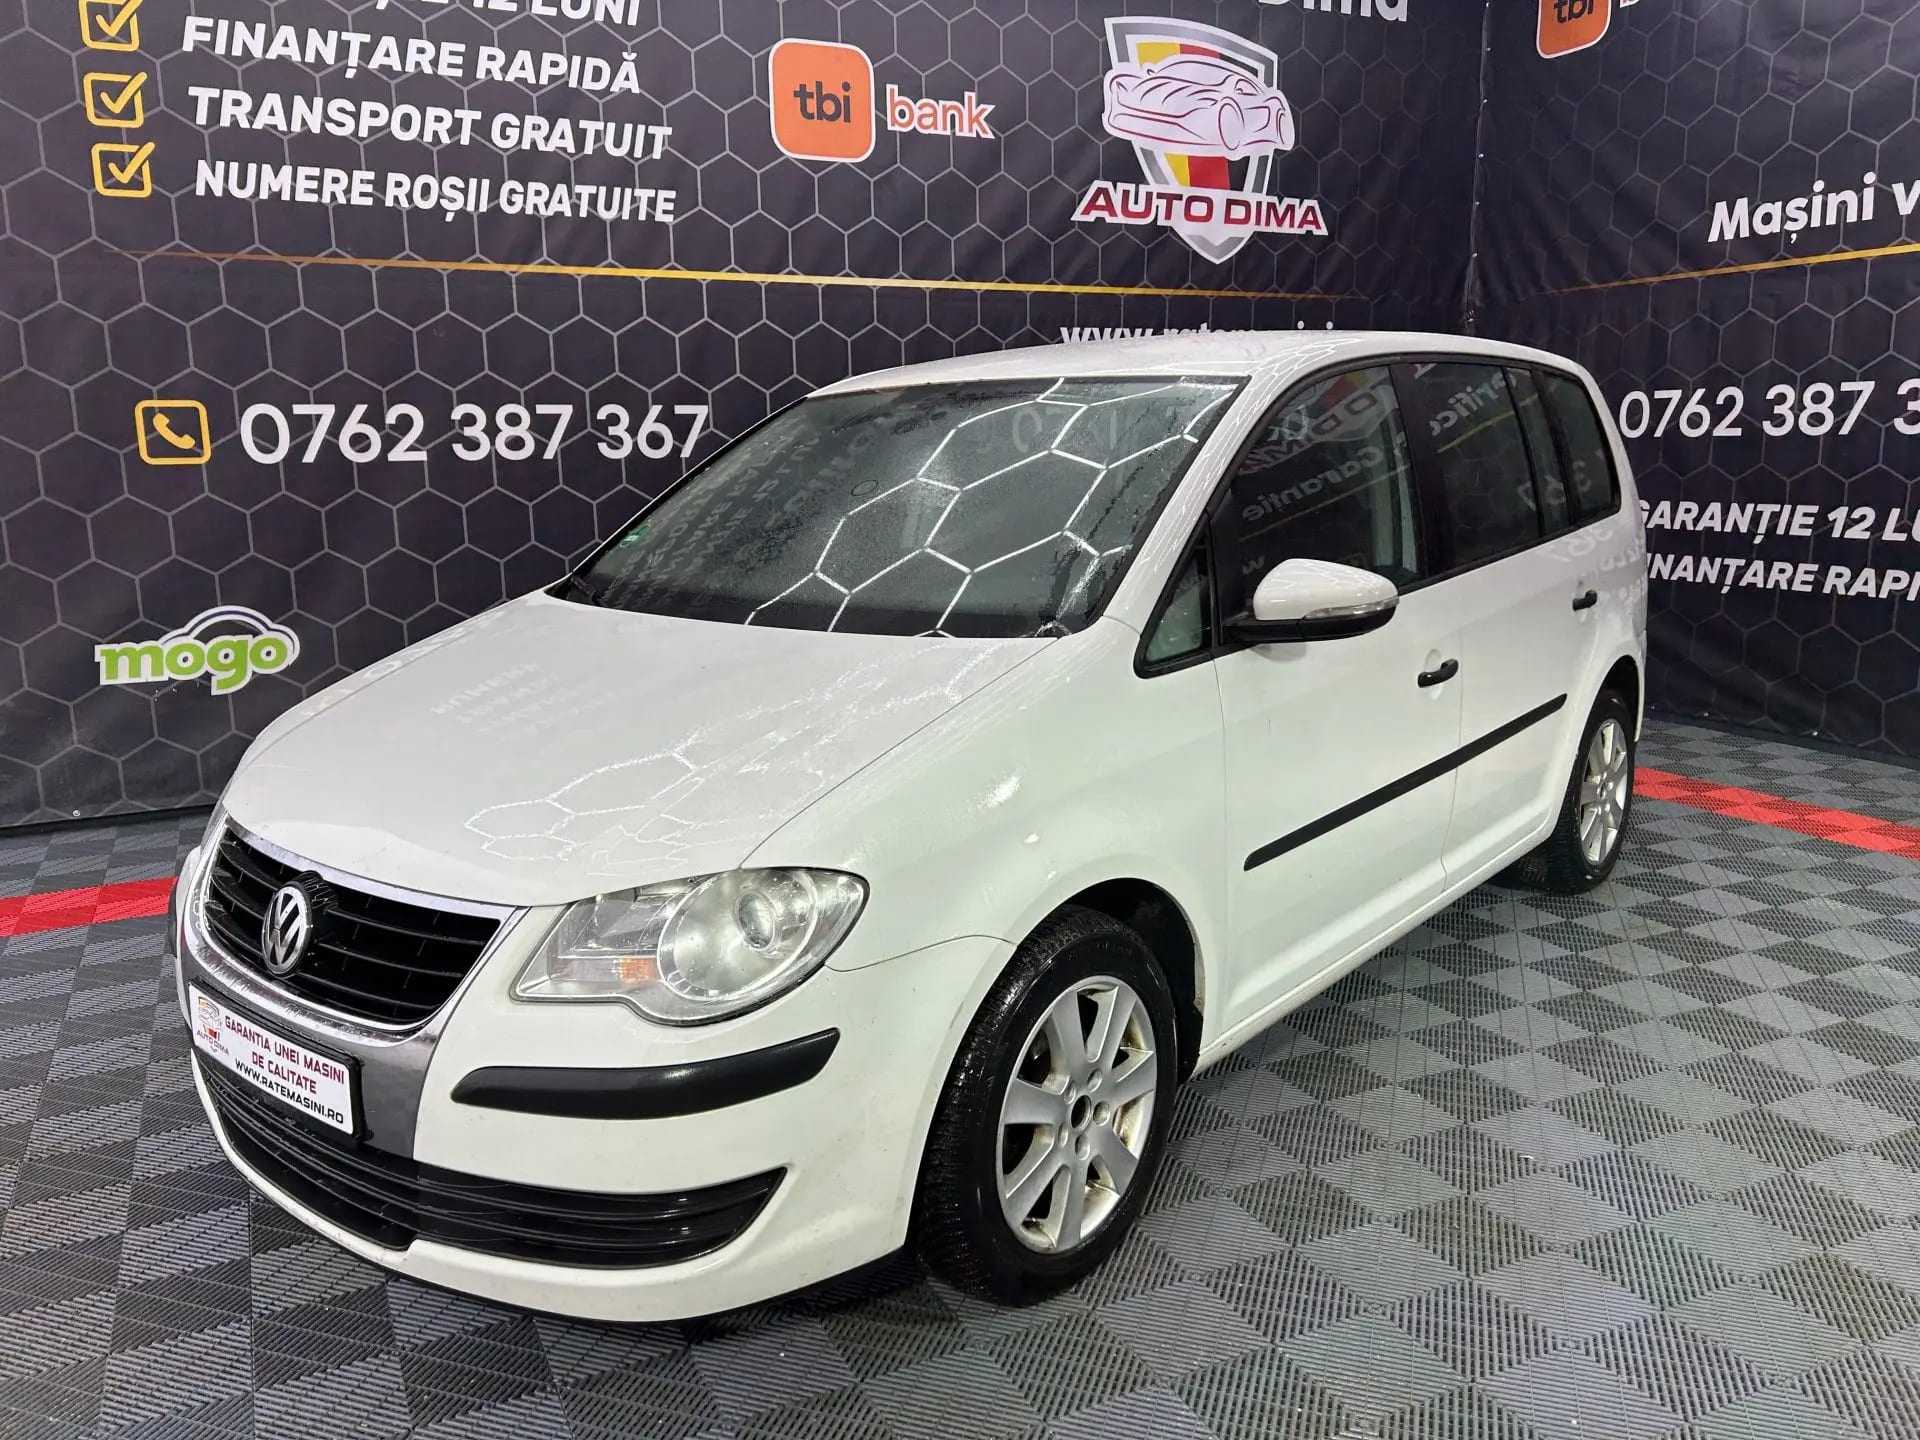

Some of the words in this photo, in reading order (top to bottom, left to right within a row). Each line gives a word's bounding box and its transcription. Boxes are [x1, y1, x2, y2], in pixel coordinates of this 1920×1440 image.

[183, 16, 465, 79] FINANȚARE
[475, 46, 641, 94] RAPIDĂ
[188, 86, 482, 146] TRANSPORT
[490, 112, 673, 160] GRATUIT
[793, 81, 852, 124] tbi
[889, 90, 992, 137] bank
[195, 159, 375, 206] NUMERE
[384, 172, 490, 222] ROȘII
[499, 180, 677, 223] GRATUITE
[1080, 187, 1210, 226] AUTO
[1223, 198, 1323, 233] DIMA
[1707, 171, 1877, 244] Mașini
[240, 403, 428, 465] 0762
[450, 403, 574, 461] 387
[596, 403, 709, 459] 367
[1619, 386, 1744, 438] 0762
[1762, 380, 1875, 437] 387
[1827, 506, 1876, 540] 12
[100, 633, 288, 691] mogo
[224, 1015, 271, 1052] GARANTIA
[274, 1041, 300, 1064] UNEI
[303, 1055, 345, 1085] MASINI
[251, 1051, 265, 1070] DE
[267, 1062, 317, 1094] CALITATE
[235, 1058, 345, 1125] WWW.RATEMASINI.RO
